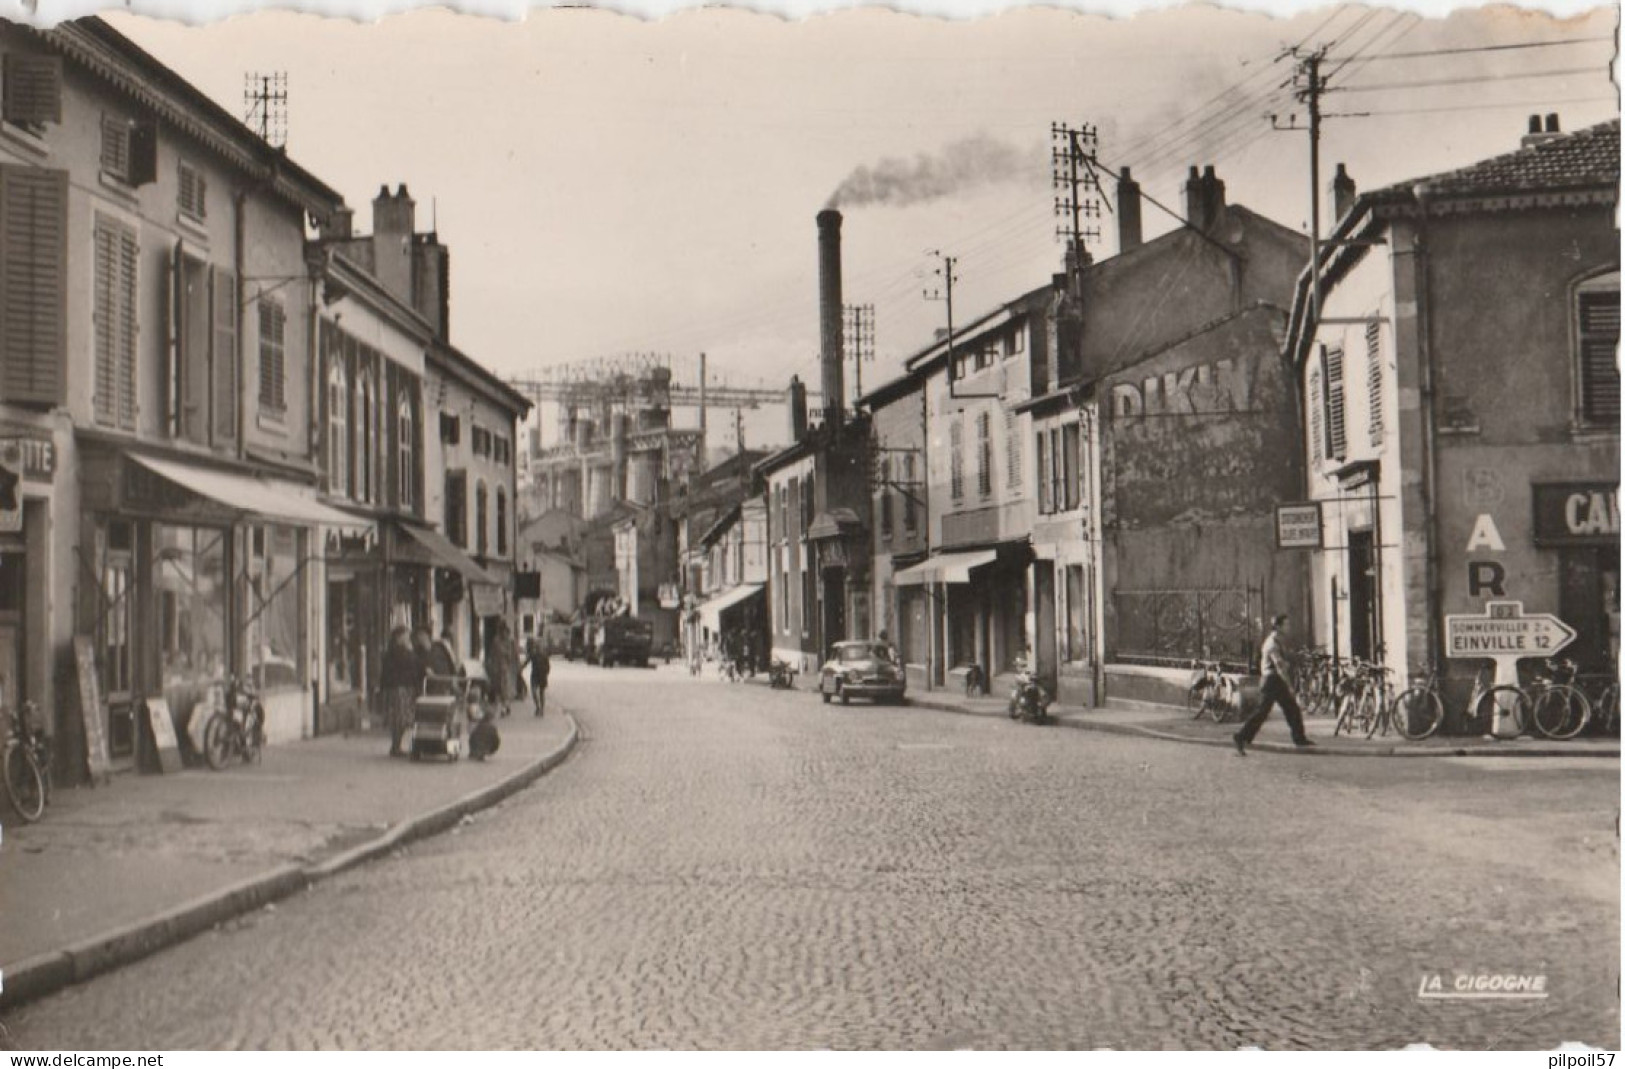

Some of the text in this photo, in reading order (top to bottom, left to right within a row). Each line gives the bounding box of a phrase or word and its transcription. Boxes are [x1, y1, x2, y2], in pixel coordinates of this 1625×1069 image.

[1453, 622, 1529, 633] SOMMERVILLER
[1454, 636, 1549, 649] EINVILLE 12
